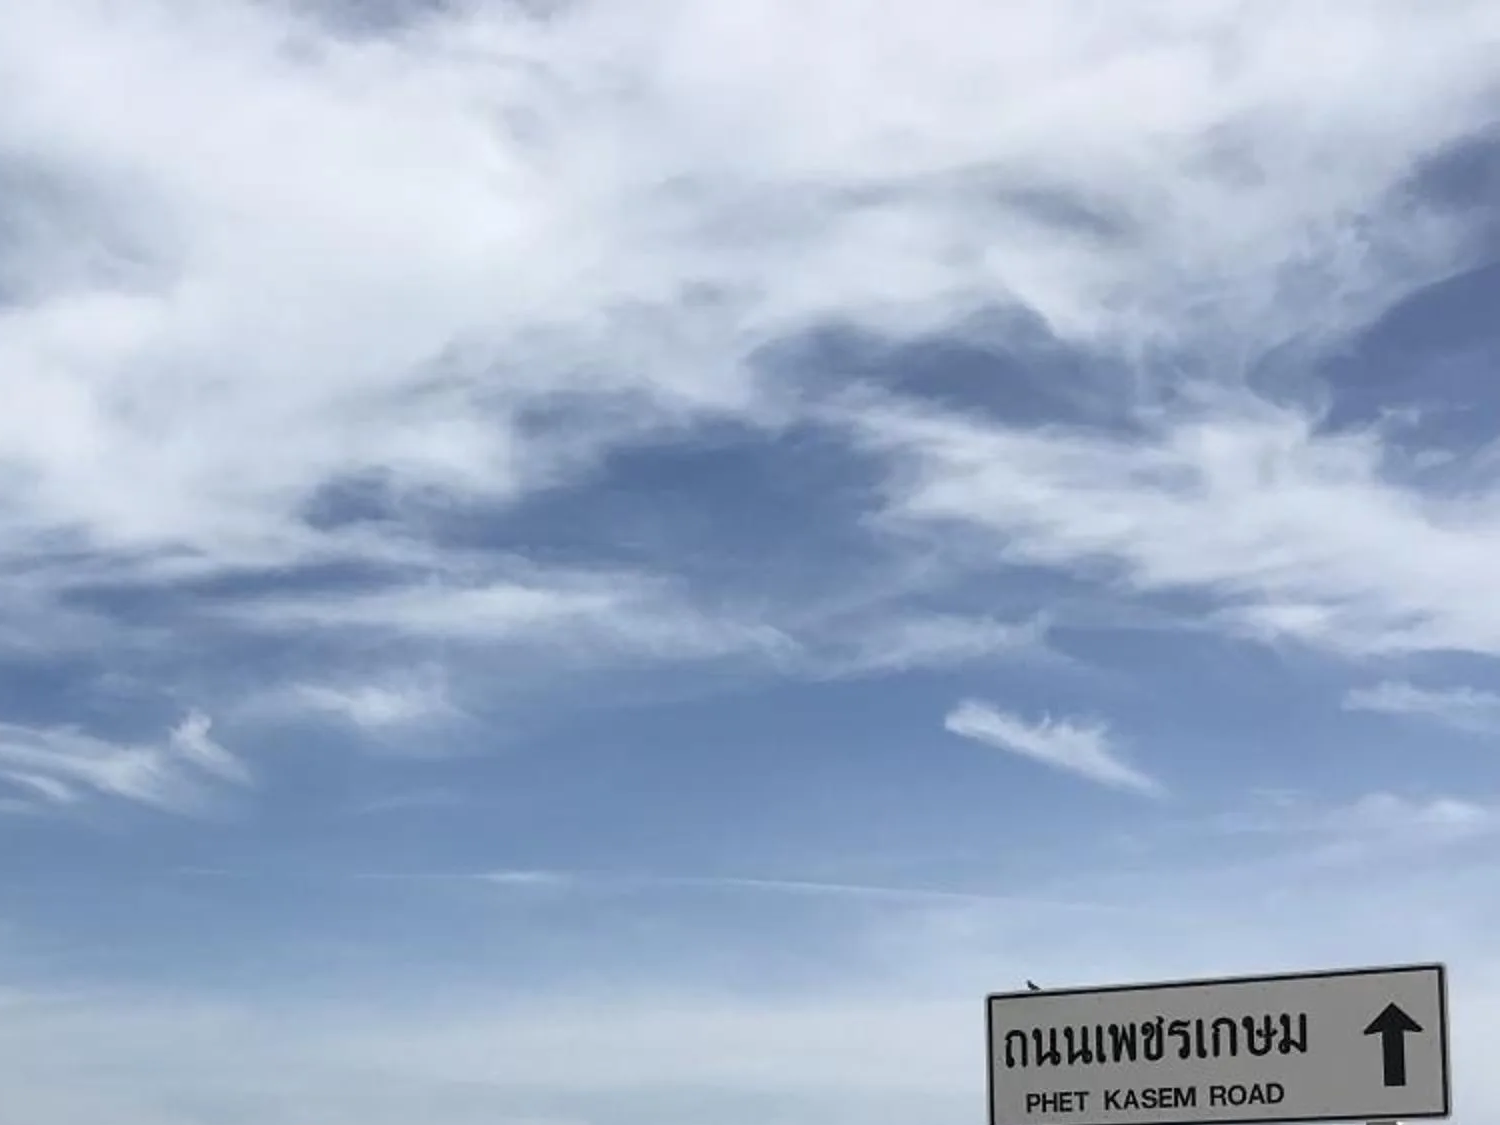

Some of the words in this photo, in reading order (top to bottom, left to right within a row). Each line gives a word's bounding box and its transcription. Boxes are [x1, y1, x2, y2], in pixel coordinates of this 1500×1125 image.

[1005, 1013, 1307, 1068] ถนนเพชรเกษม
[1026, 1091, 1090, 1113] PHET
[1104, 1086, 1197, 1110] KASEM
[1210, 1083, 1285, 1106] ROAD
